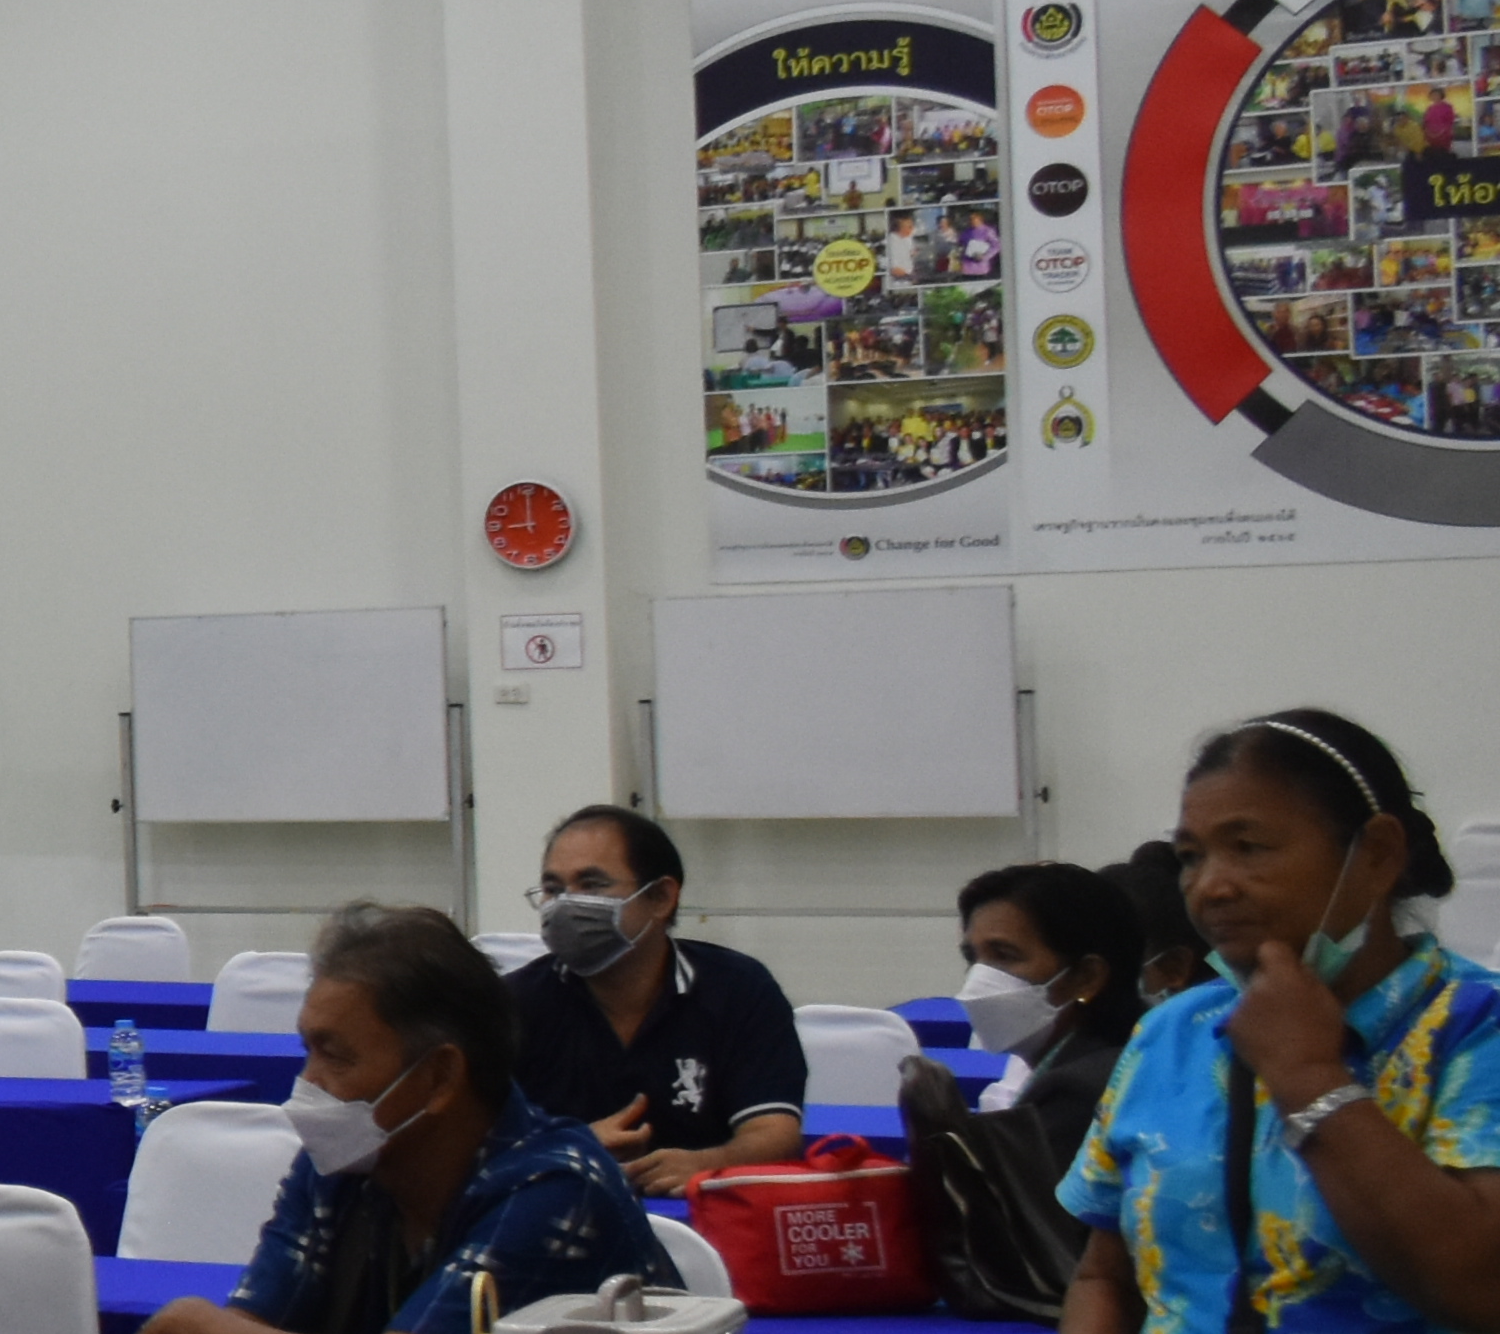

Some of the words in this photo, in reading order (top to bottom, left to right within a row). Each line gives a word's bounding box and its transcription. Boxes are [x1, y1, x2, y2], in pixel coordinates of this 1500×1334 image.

[771, 36, 912, 80] ให้ความรู้
[1035, 104, 1075, 116] OTOP
[1032, 180, 1084, 196] OTOP
[1428, 173, 1500, 207] ให้อ
[817, 258, 870, 274] OTOP
[1035, 256, 1086, 271] OTOP
[874, 538, 930, 554] Change
[934, 536, 955, 549] for
[959, 535, 1001, 548] Good
[787, 1210, 837, 1224] MORE
[787, 1222, 871, 1243] COOLER
[790, 1243, 818, 1254] FOR
[791, 1254, 830, 1269] YOU
